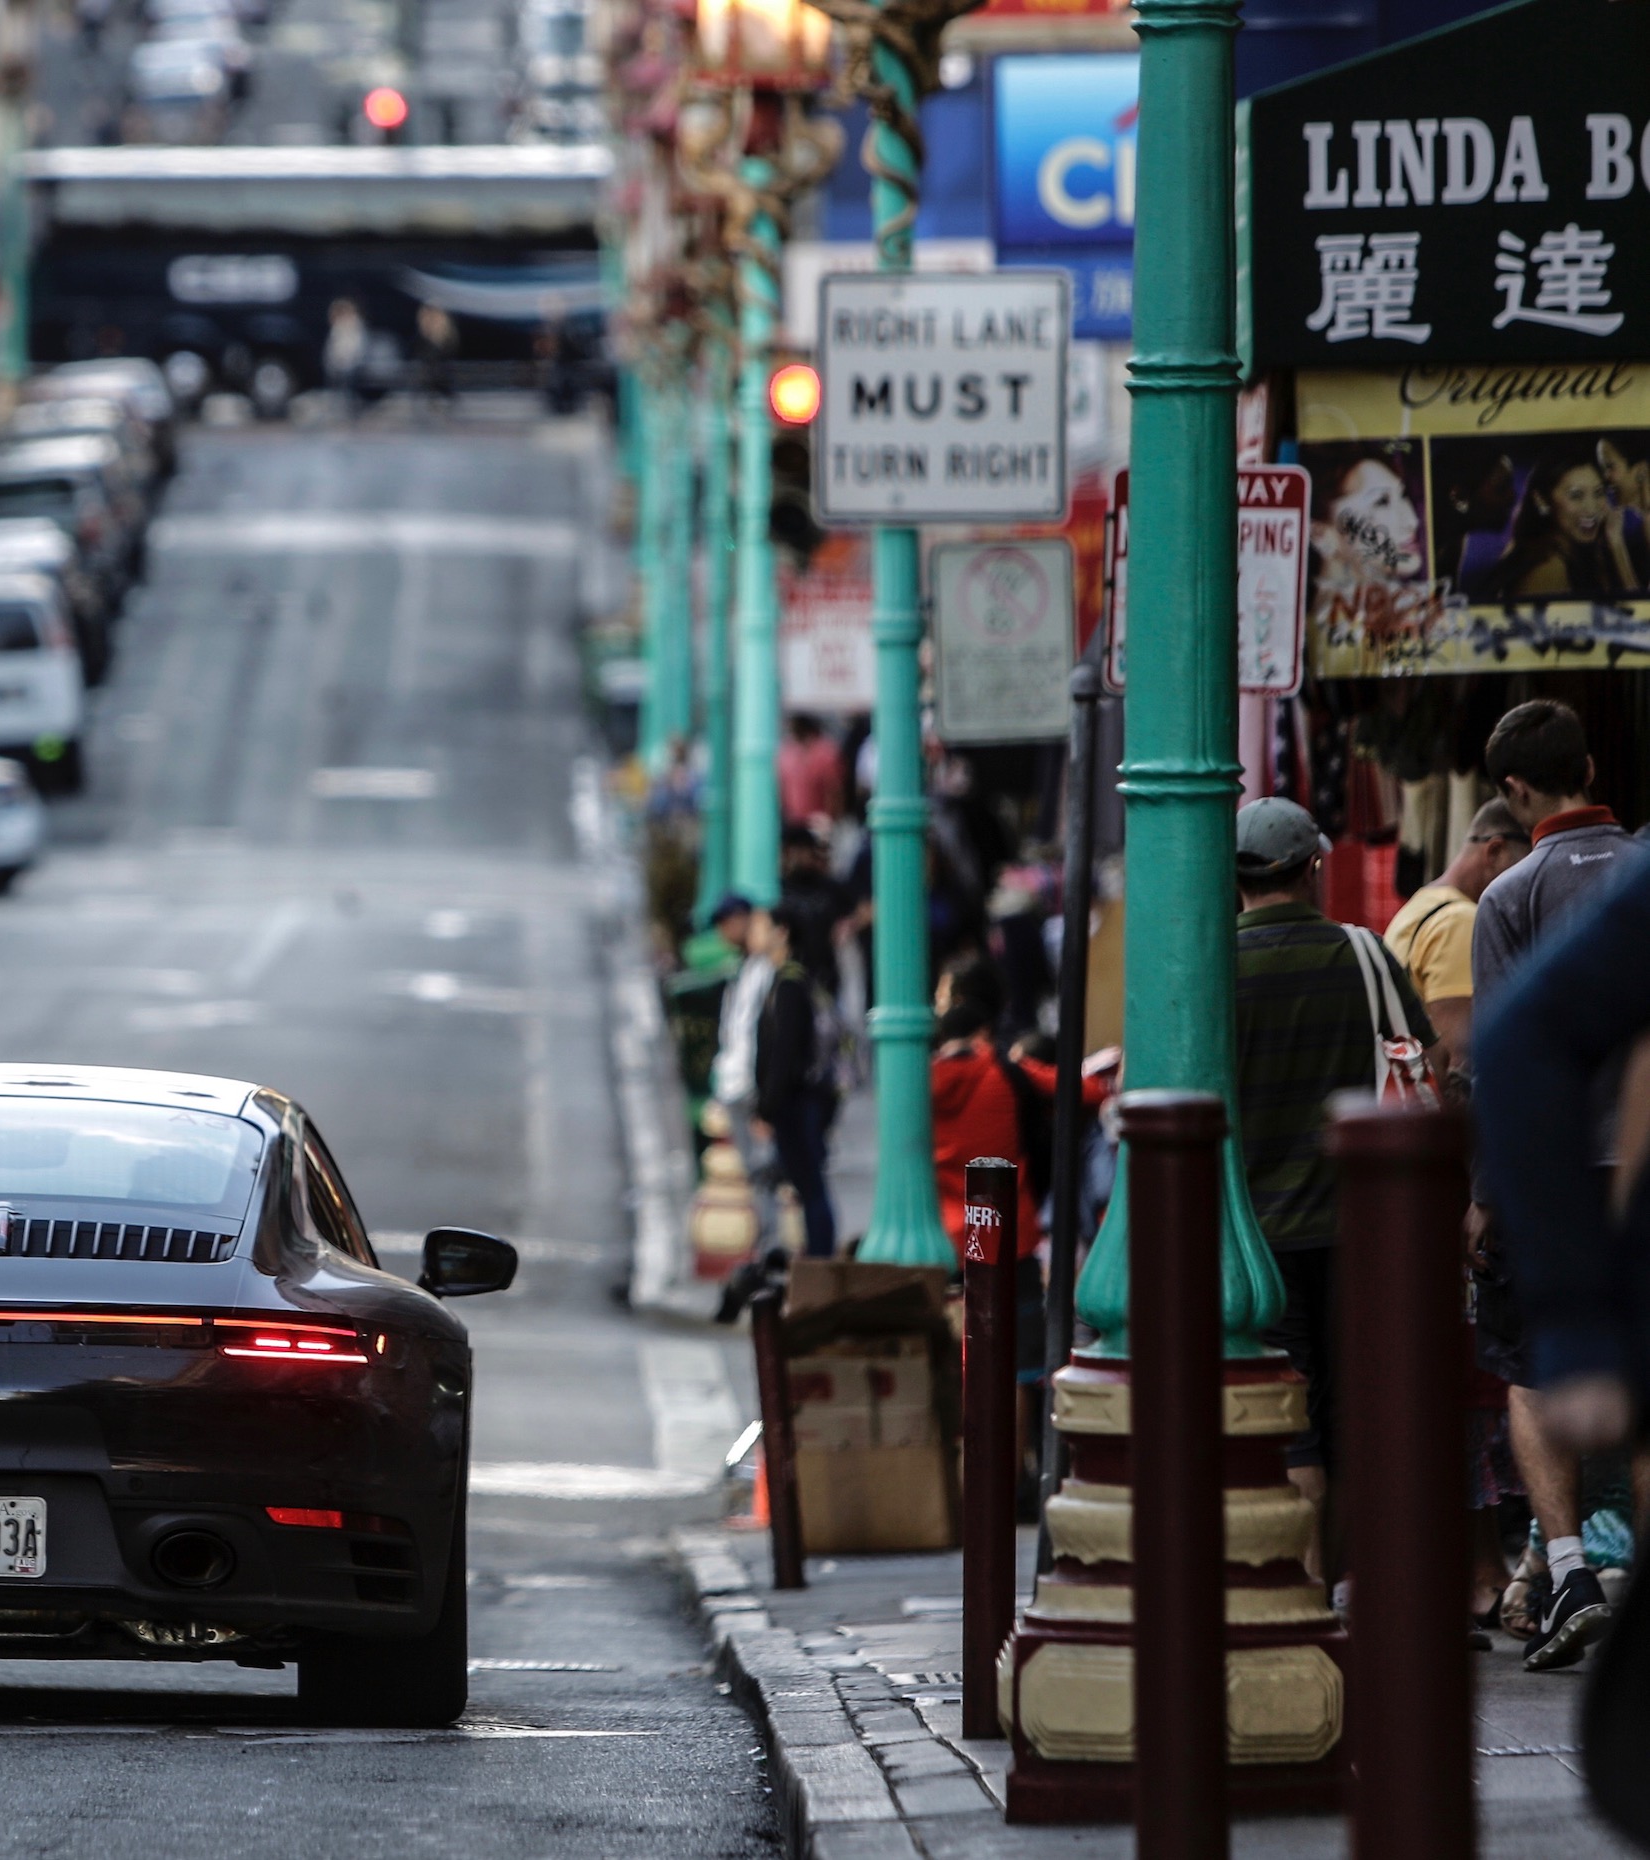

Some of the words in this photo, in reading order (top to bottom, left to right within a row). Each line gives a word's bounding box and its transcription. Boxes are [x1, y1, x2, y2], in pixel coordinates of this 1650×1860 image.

[1302, 115, 1550, 210] LINDA
[1585, 112, 1650, 200] B
[1306, 222, 1625, 344] 麗達
[834, 307, 938, 349] RIGHT
[952, 307, 1052, 349] LANE
[852, 371, 1032, 422] MUST
[834, 444, 927, 484] TURN
[947, 444, 1050, 484] RIGHT
